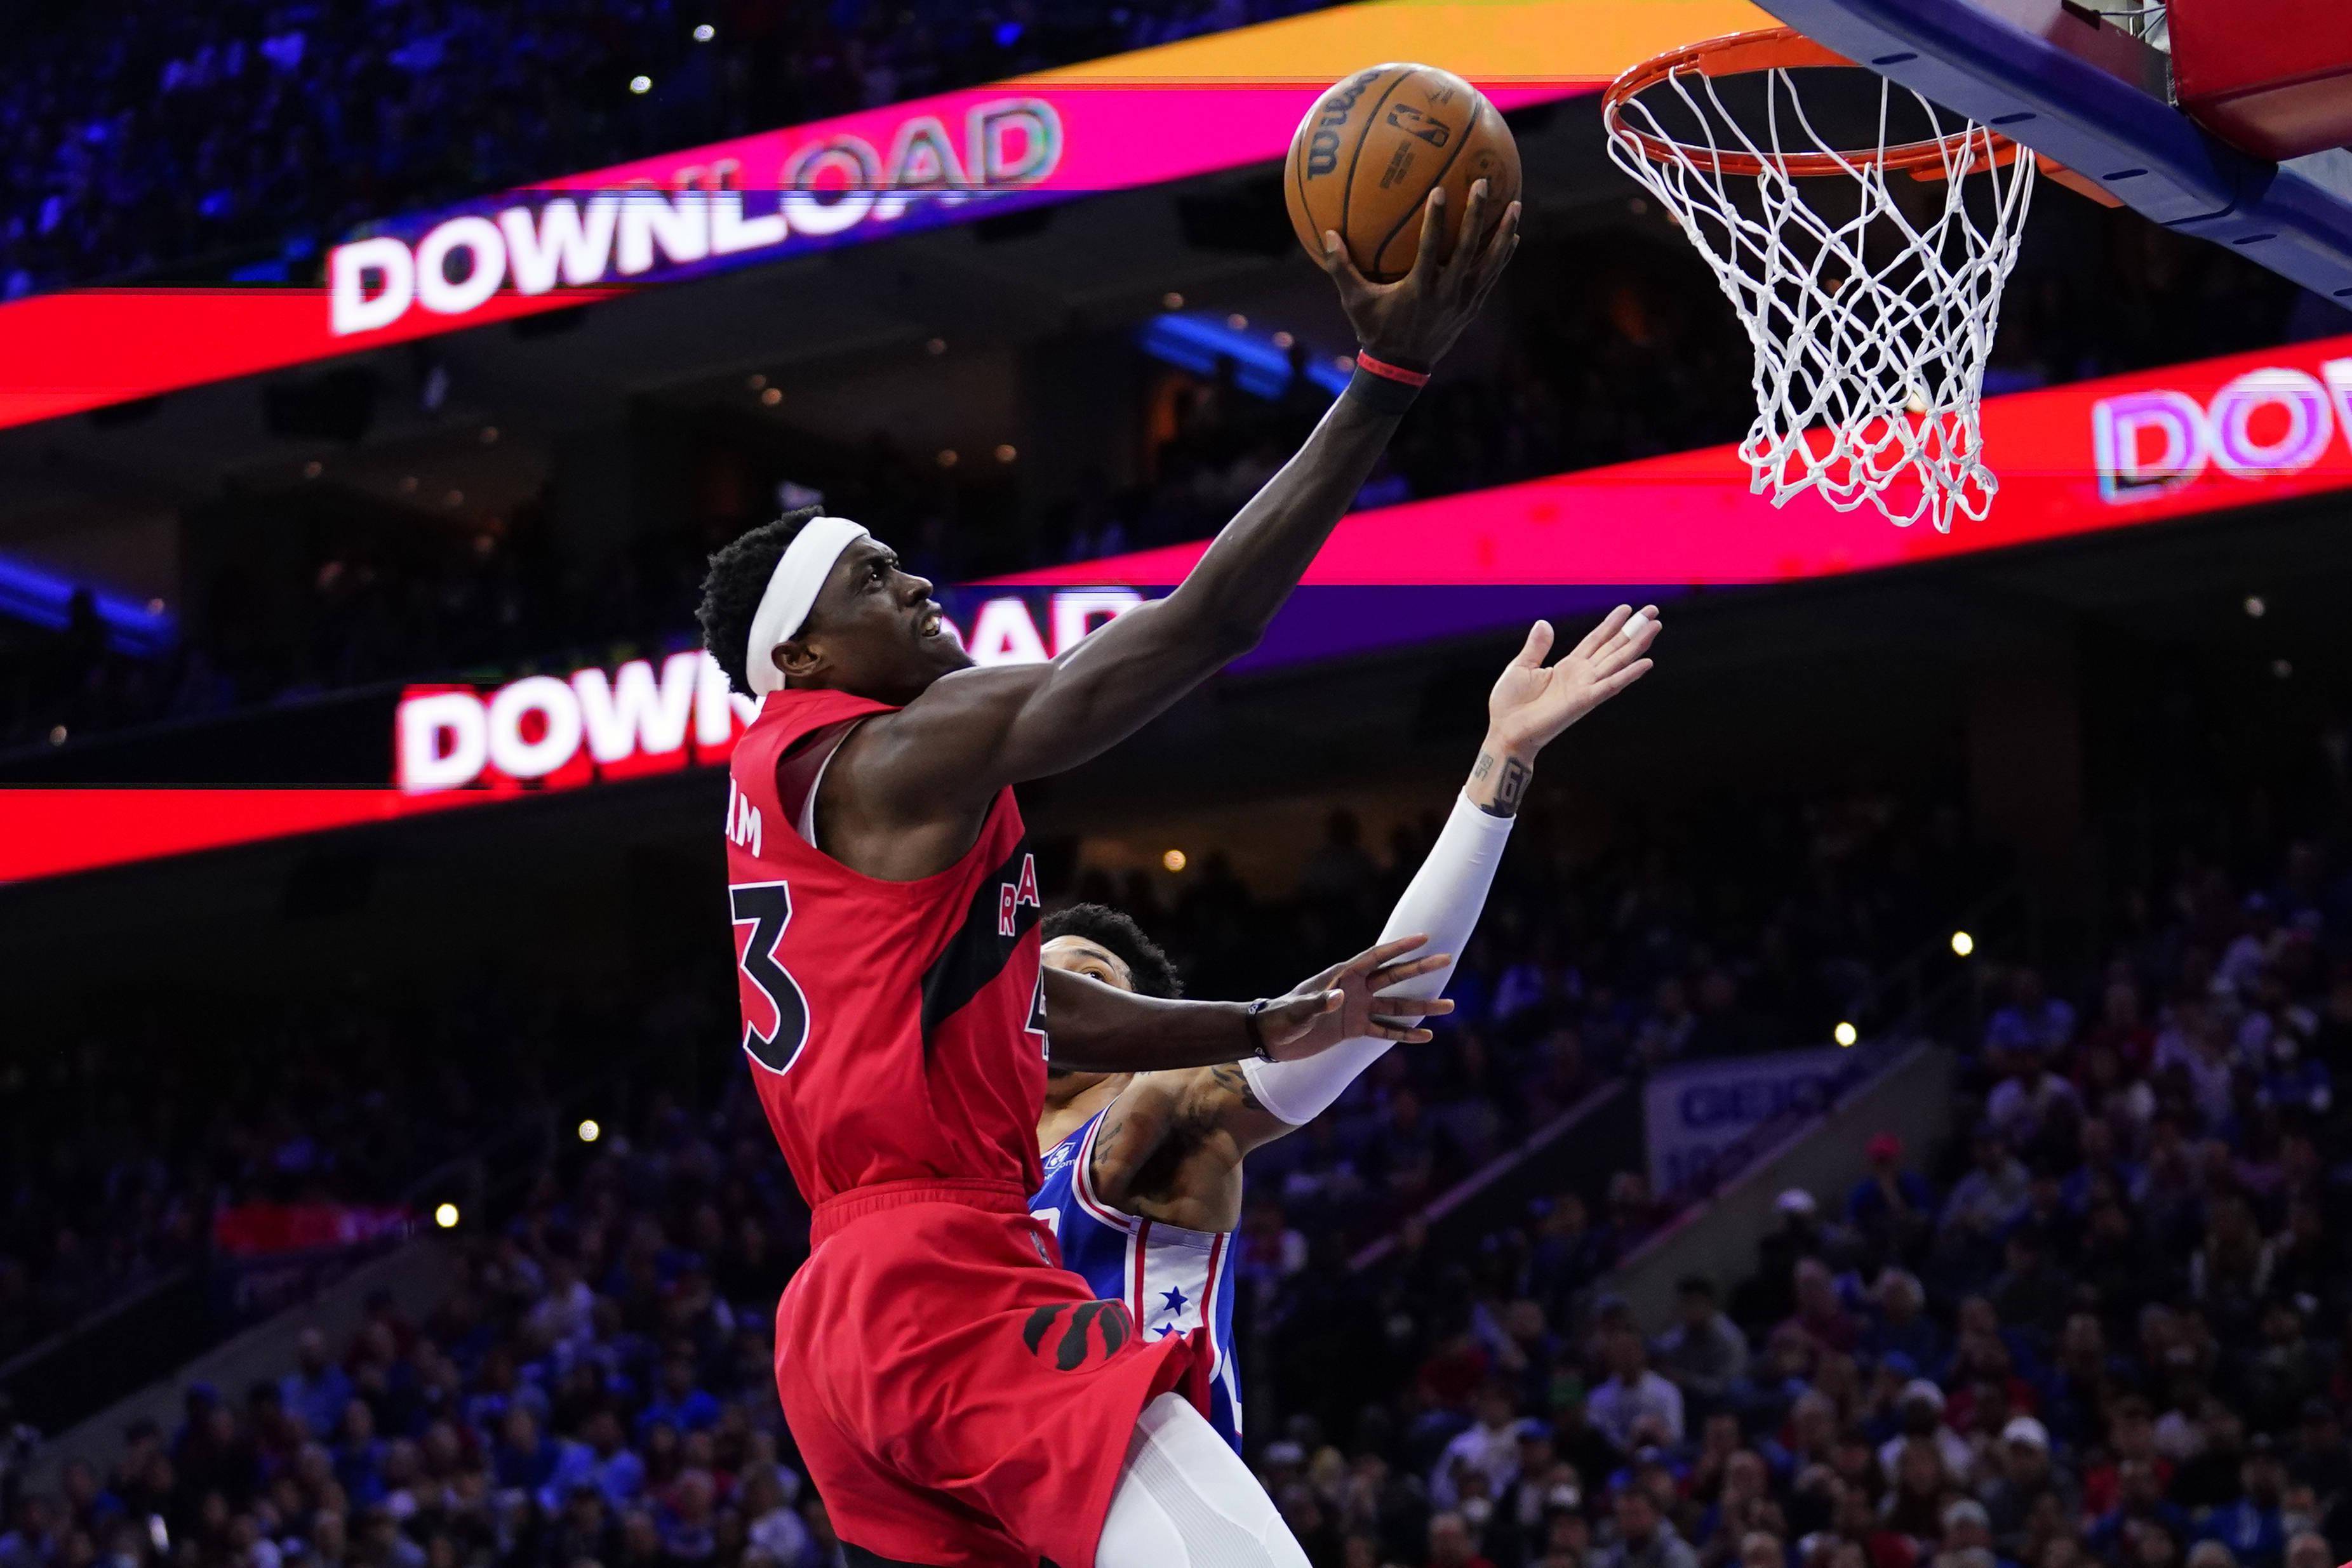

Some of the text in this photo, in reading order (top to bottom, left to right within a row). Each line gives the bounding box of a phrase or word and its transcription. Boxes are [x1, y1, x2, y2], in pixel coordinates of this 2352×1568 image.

[329, 97, 1062, 333] DOWNLOAD
[2093, 357, 2352, 505] DO
[728, 880, 810, 1076] 3
